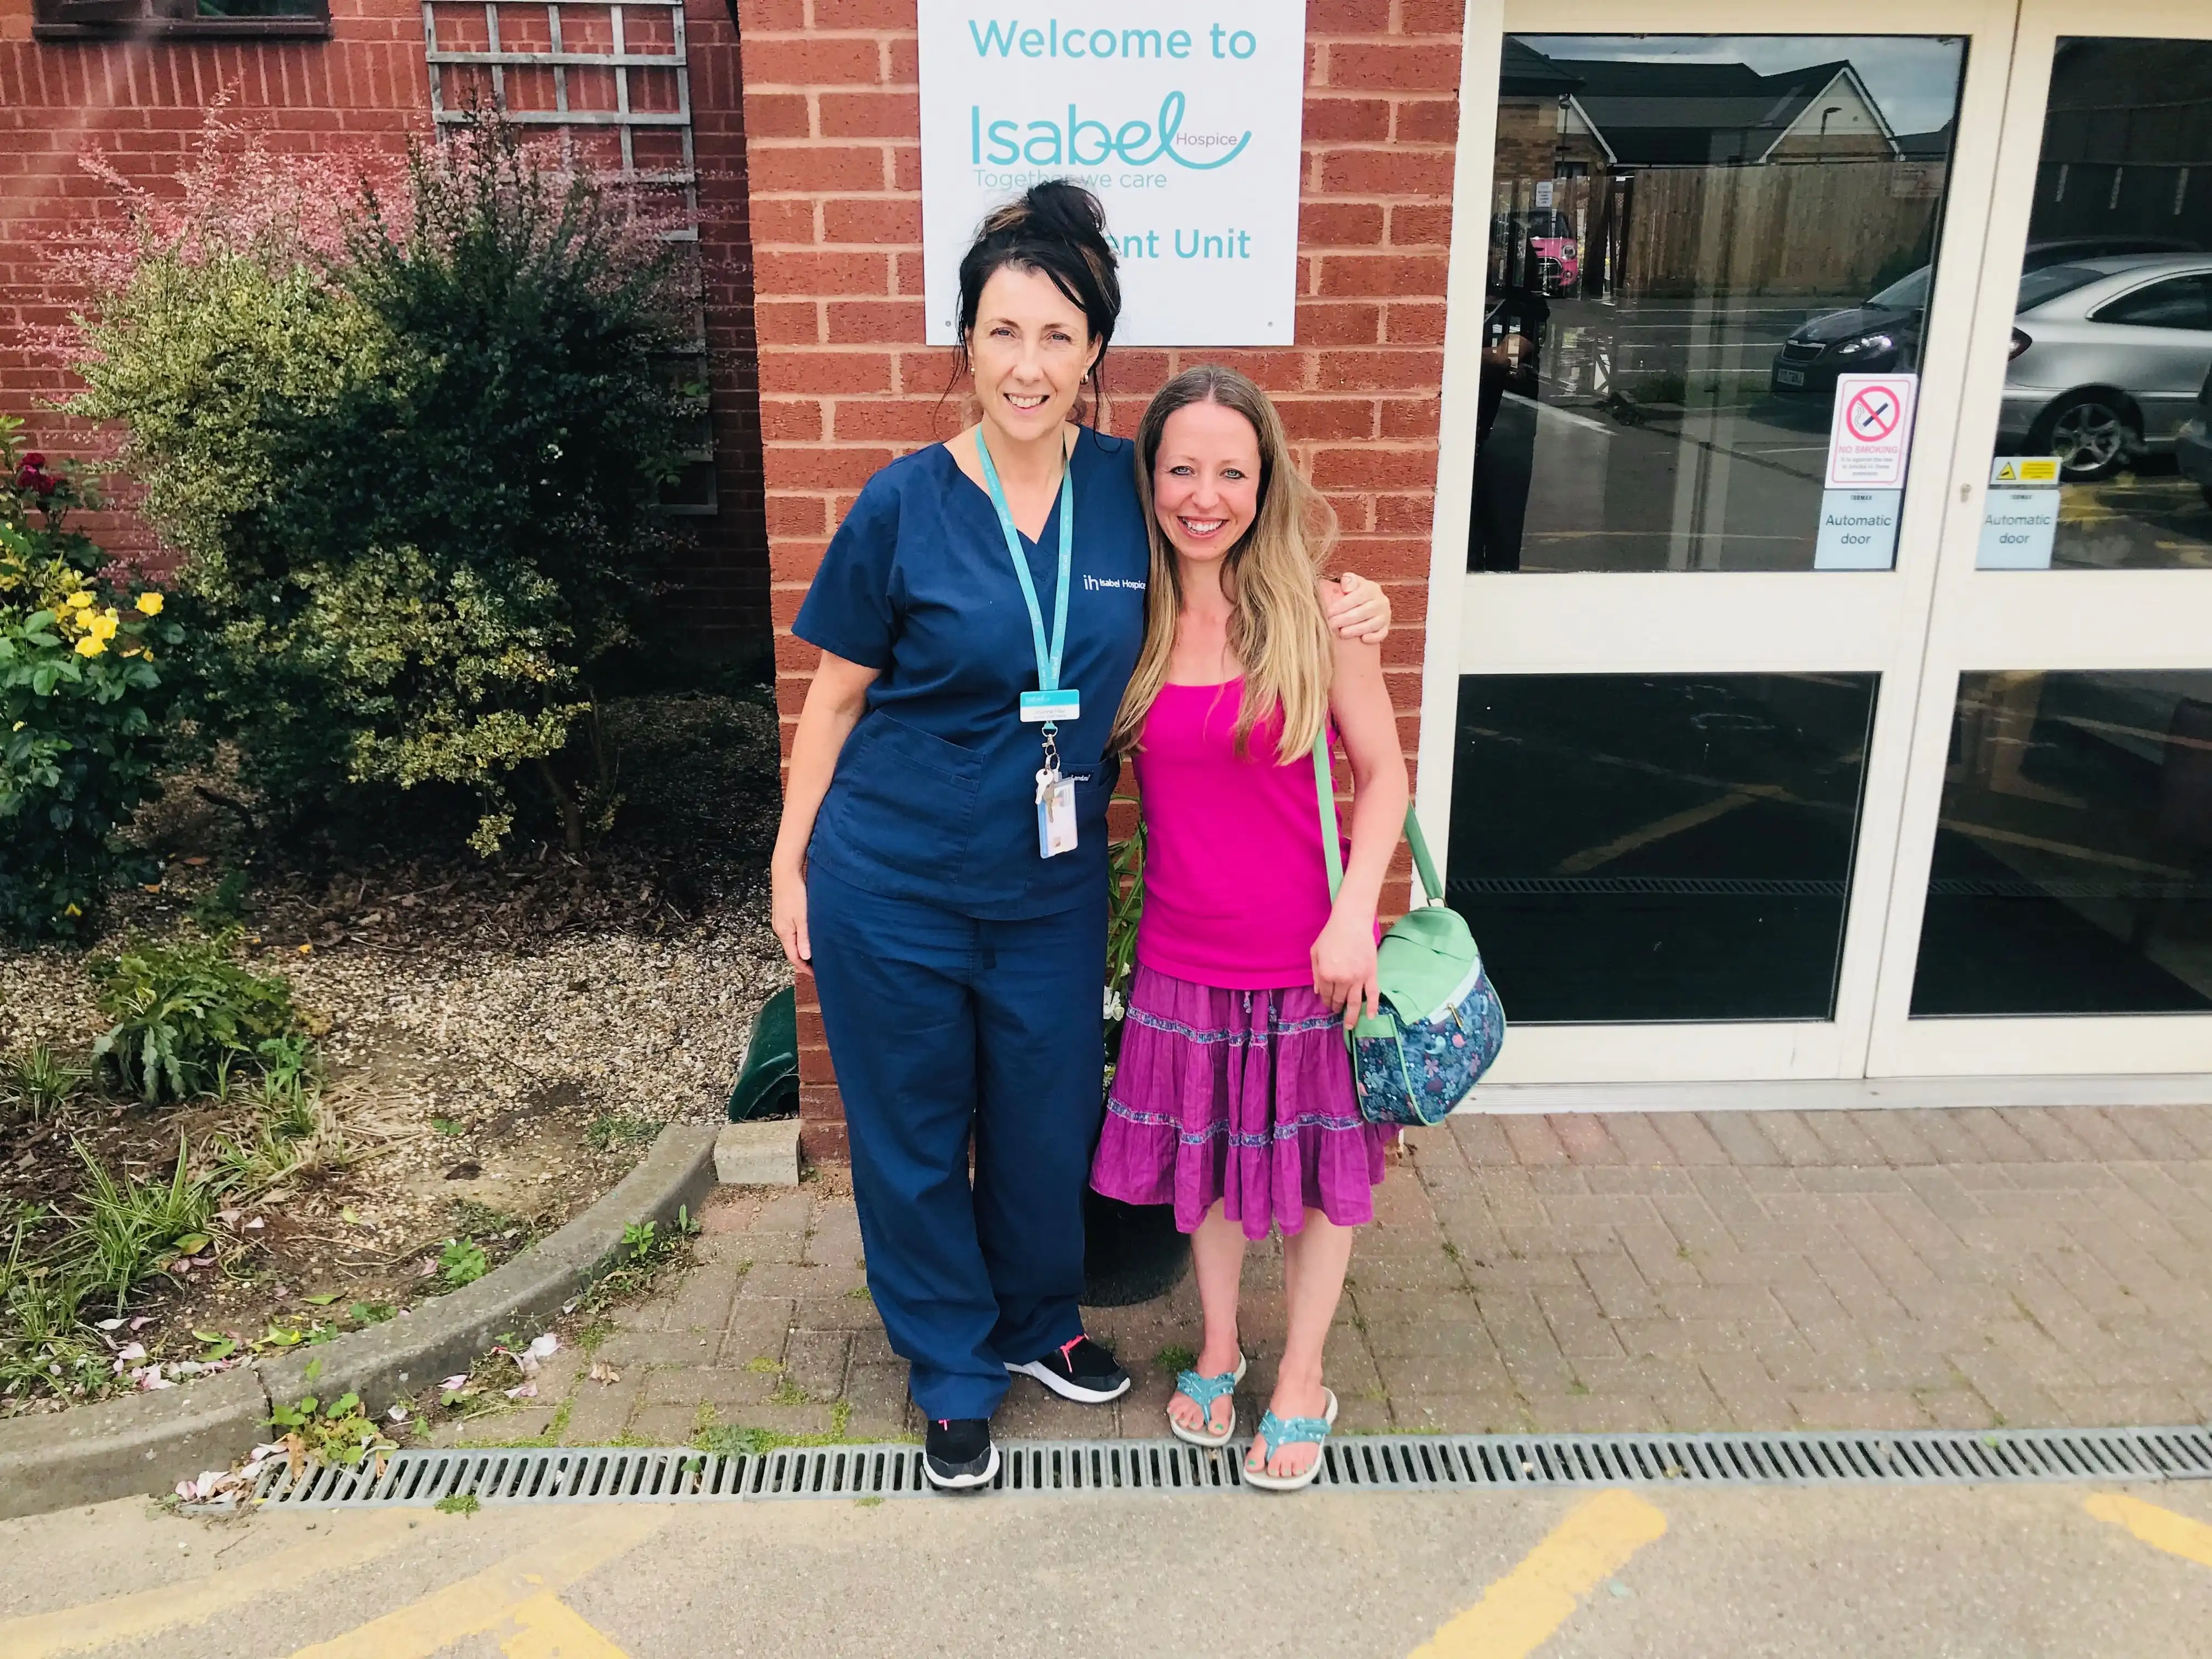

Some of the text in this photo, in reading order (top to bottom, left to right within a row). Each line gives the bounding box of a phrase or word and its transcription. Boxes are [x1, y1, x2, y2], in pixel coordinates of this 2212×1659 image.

[968, 19, 1256, 59] Welcome to
[972, 91, 1252, 170] Isabel
[1176, 132, 1238, 148] Hospice
[1080, 173, 1111, 188] we
[1119, 173, 1167, 188] care
[1175, 228, 1251, 258] Unit
[1838, 445, 1898, 454] NO SMOKING
[1825, 514, 1892, 526] Automatic
[1984, 515, 2051, 526] Automatic
[1841, 533, 1871, 544] door
[1999, 533, 2030, 544] door
[1099, 578, 1120, 588] Isabel
